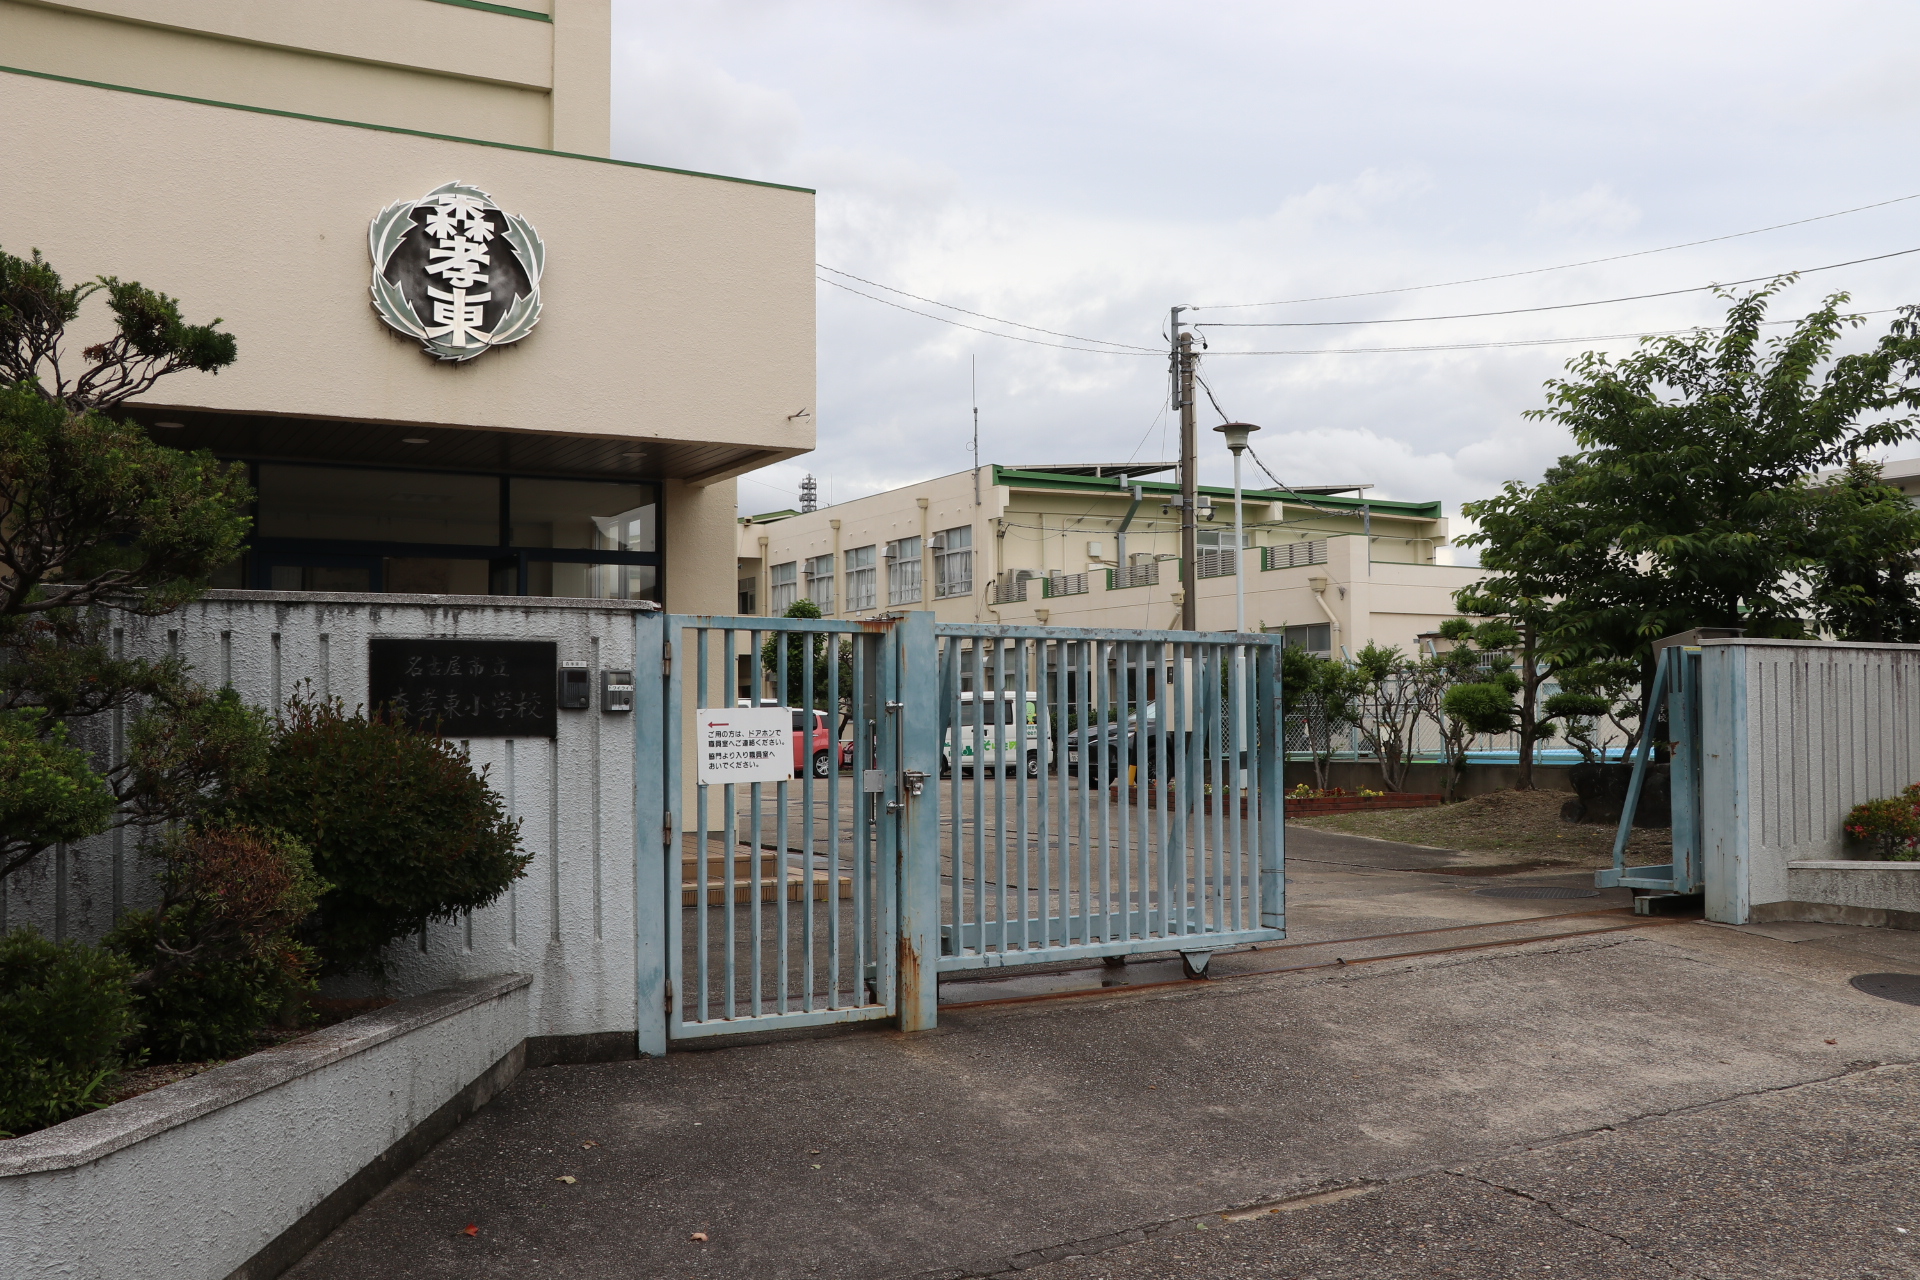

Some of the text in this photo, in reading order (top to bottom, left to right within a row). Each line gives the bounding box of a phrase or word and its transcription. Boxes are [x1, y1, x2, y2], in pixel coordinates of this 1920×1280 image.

[404, 655, 510, 678] 名古屋市立
[708, 762, 759, 770] おいでください。
